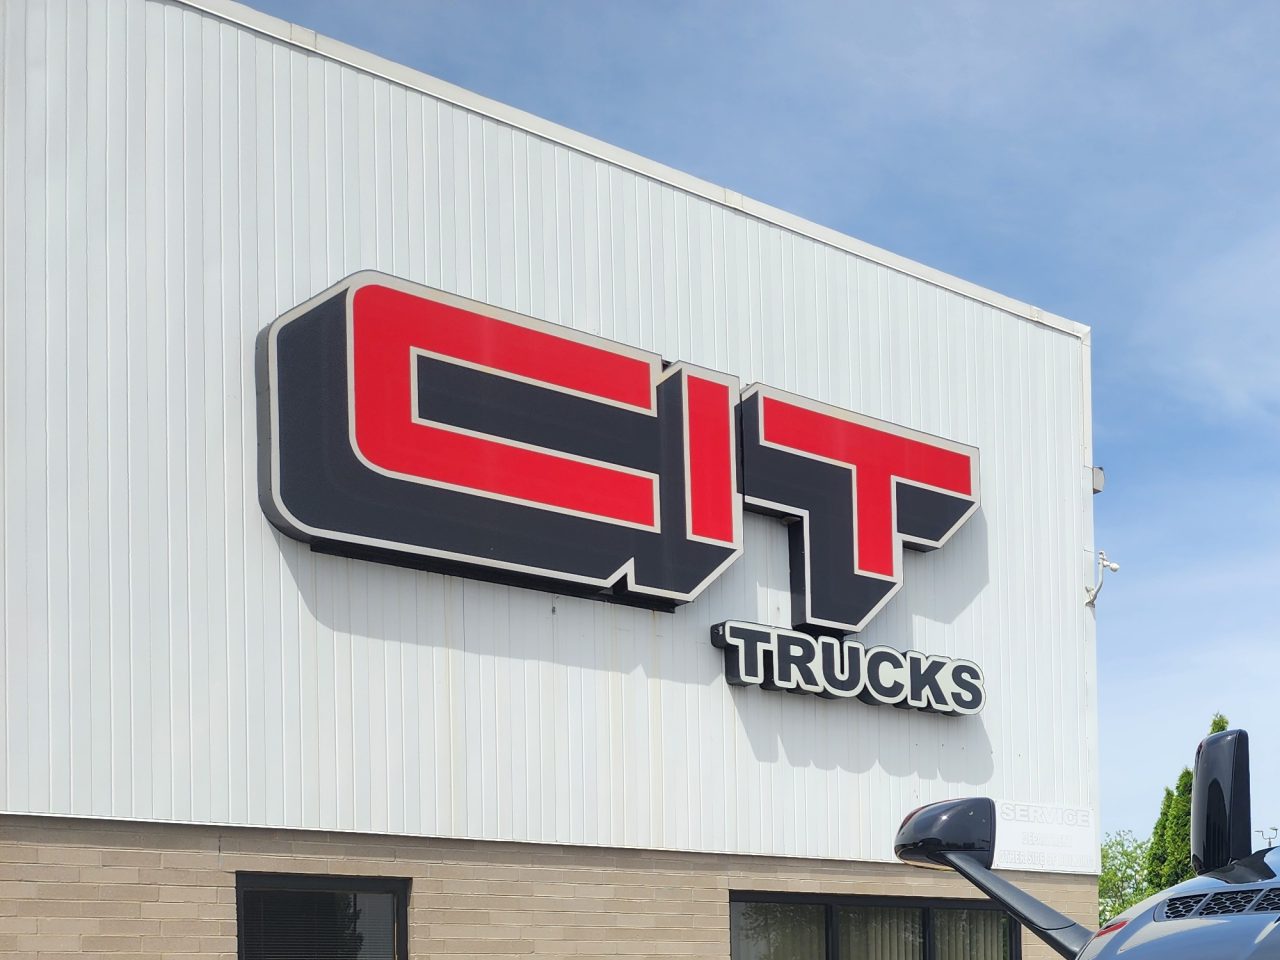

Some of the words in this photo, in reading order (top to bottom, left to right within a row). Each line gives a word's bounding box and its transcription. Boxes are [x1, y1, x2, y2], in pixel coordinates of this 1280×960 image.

[346, 280, 980, 580] CIT
[728, 624, 984, 710] TRUCKS
[1001, 803, 1090, 827] SERVICE
